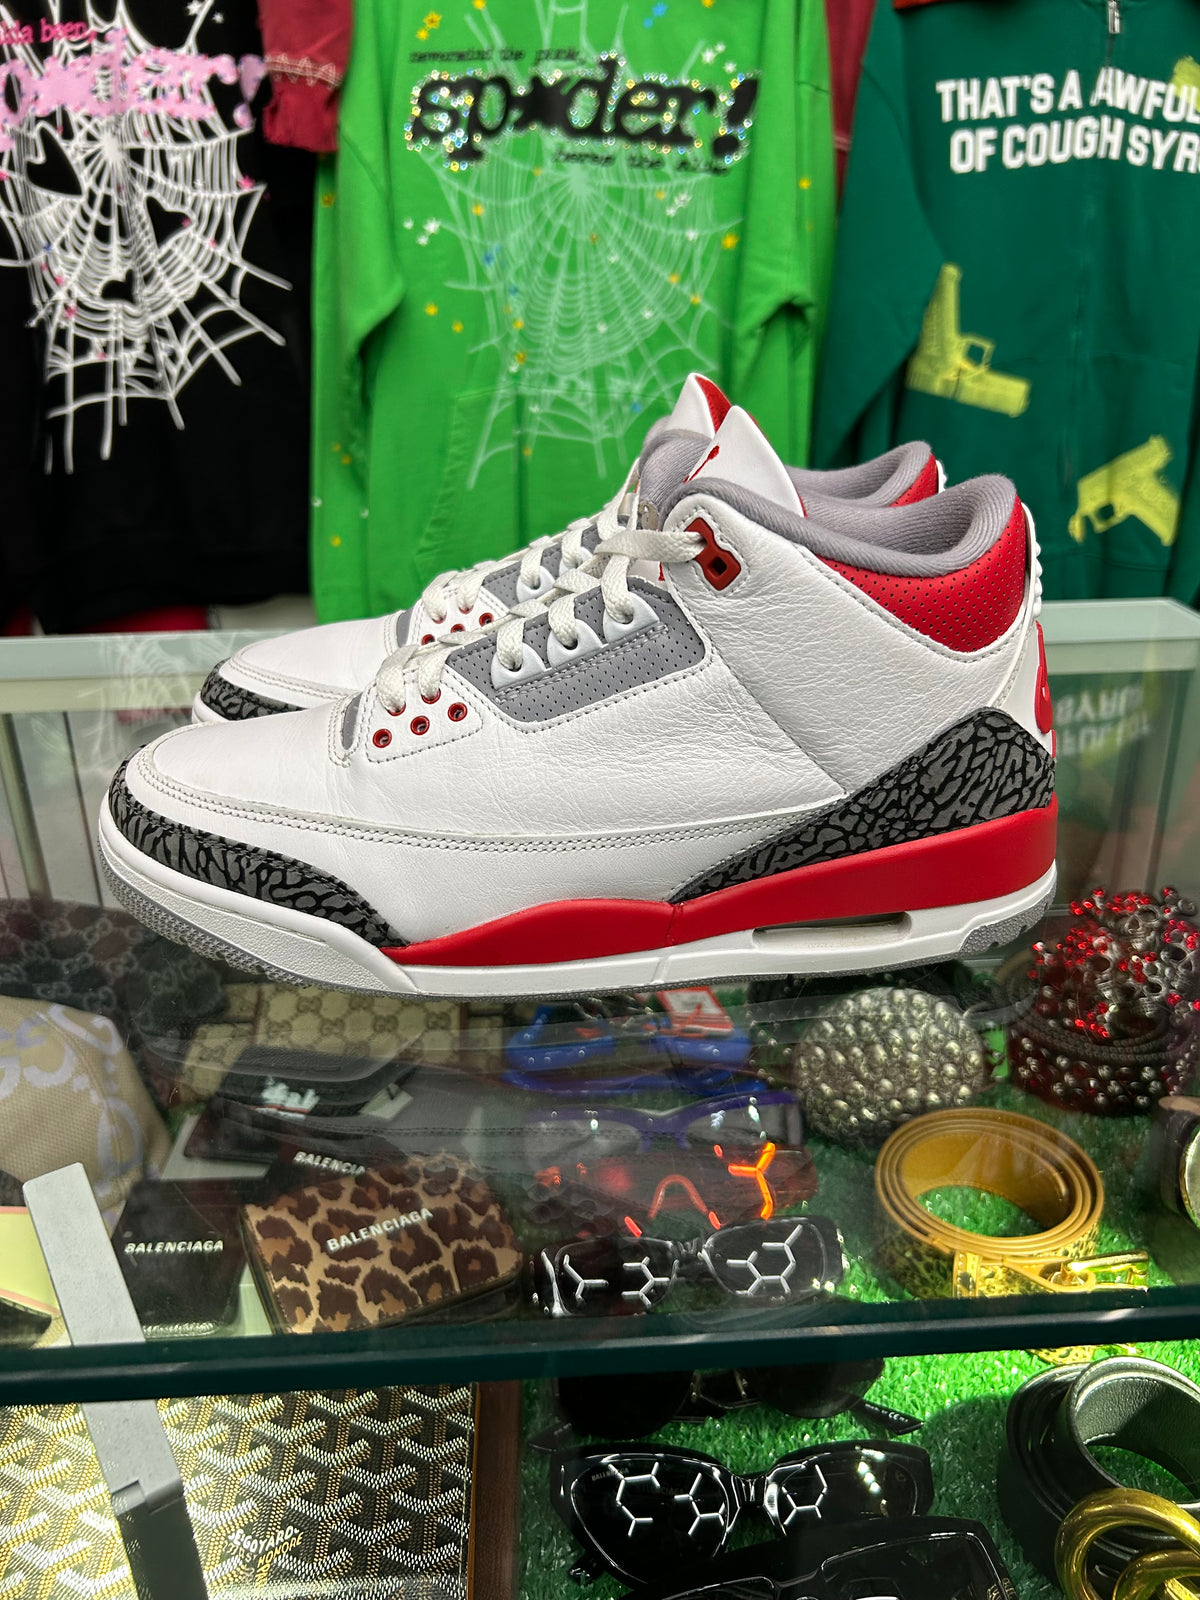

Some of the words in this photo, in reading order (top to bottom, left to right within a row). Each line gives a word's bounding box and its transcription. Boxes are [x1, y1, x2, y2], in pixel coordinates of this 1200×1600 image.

[936, 73, 1055, 123] THAT'S
[1058, 69, 1083, 111] A
[1089, 66, 1200, 124] AWFUL
[950, 126, 998, 174] OF
[1002, 115, 1125, 170] COUGH
[1126, 124, 1200, 174] SYR
[124, 1240, 224, 1254] BALENCIAGA
[326, 1206, 433, 1253] BALENCIAGA
